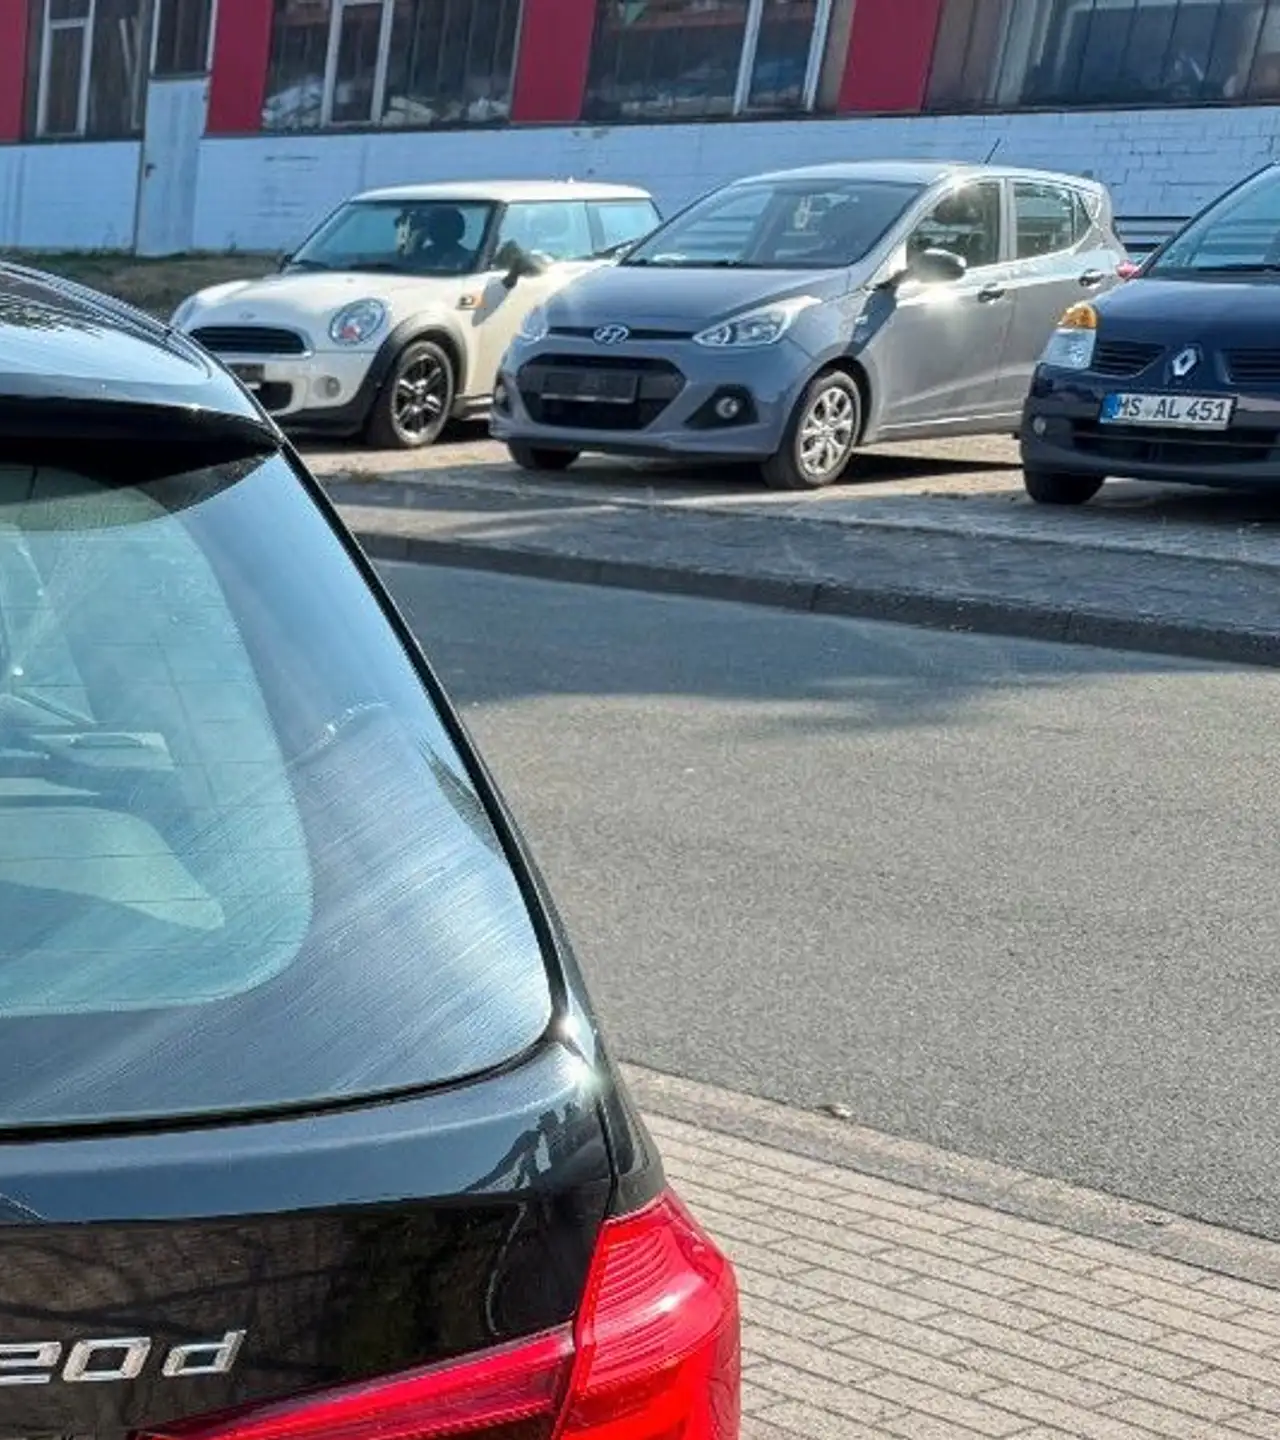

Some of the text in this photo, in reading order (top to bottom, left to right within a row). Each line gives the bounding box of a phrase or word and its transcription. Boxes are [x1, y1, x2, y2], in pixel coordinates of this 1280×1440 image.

[1117, 396, 1225, 422] MS AL 451
